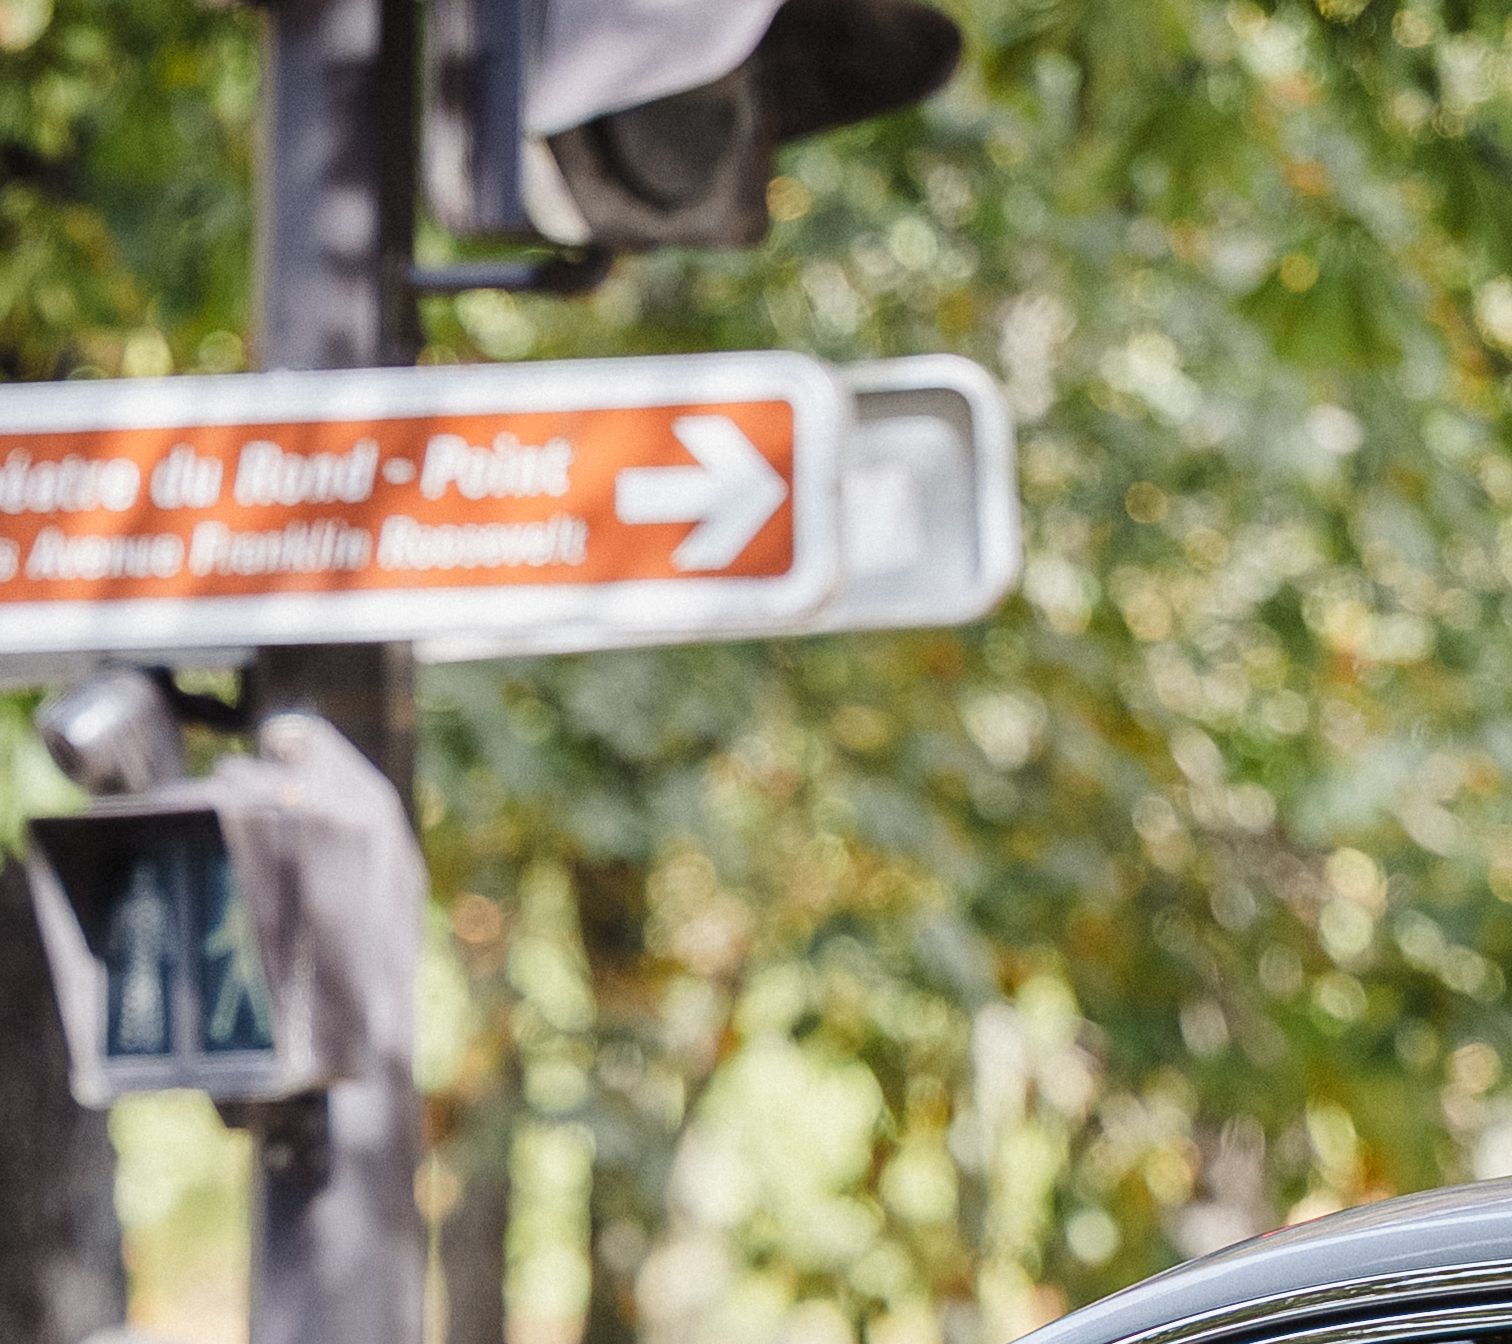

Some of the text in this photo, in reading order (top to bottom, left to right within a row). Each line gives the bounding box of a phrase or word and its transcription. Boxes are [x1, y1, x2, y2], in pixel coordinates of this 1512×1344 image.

[150, 441, 224, 511] du
[233, 438, 380, 508] Rond
[419, 431, 572, 501] Point
